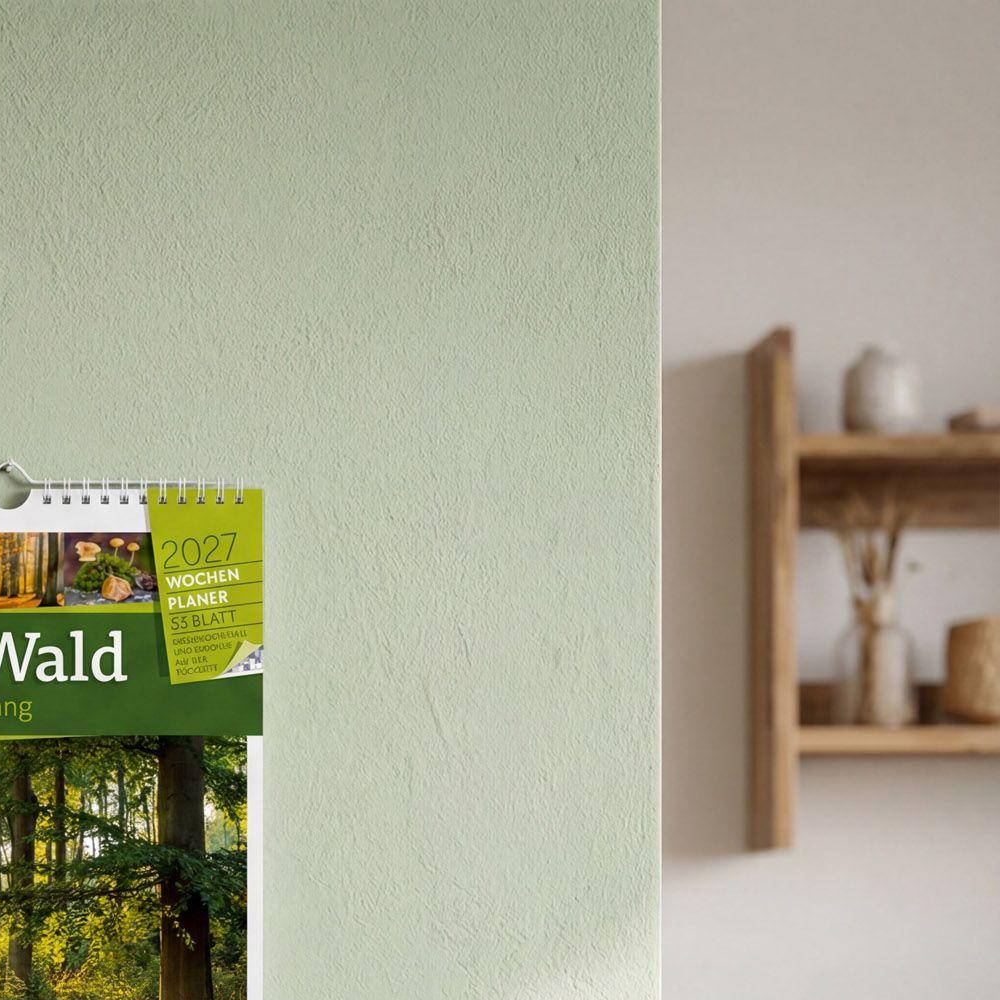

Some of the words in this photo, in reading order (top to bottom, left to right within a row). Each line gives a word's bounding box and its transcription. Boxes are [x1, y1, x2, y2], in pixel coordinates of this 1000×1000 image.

[162, 532, 237, 569] 2027
[165, 568, 240, 589] WOCHEN
[168, 590, 229, 610] PLANER
[192, 609, 236, 628] BLATT
